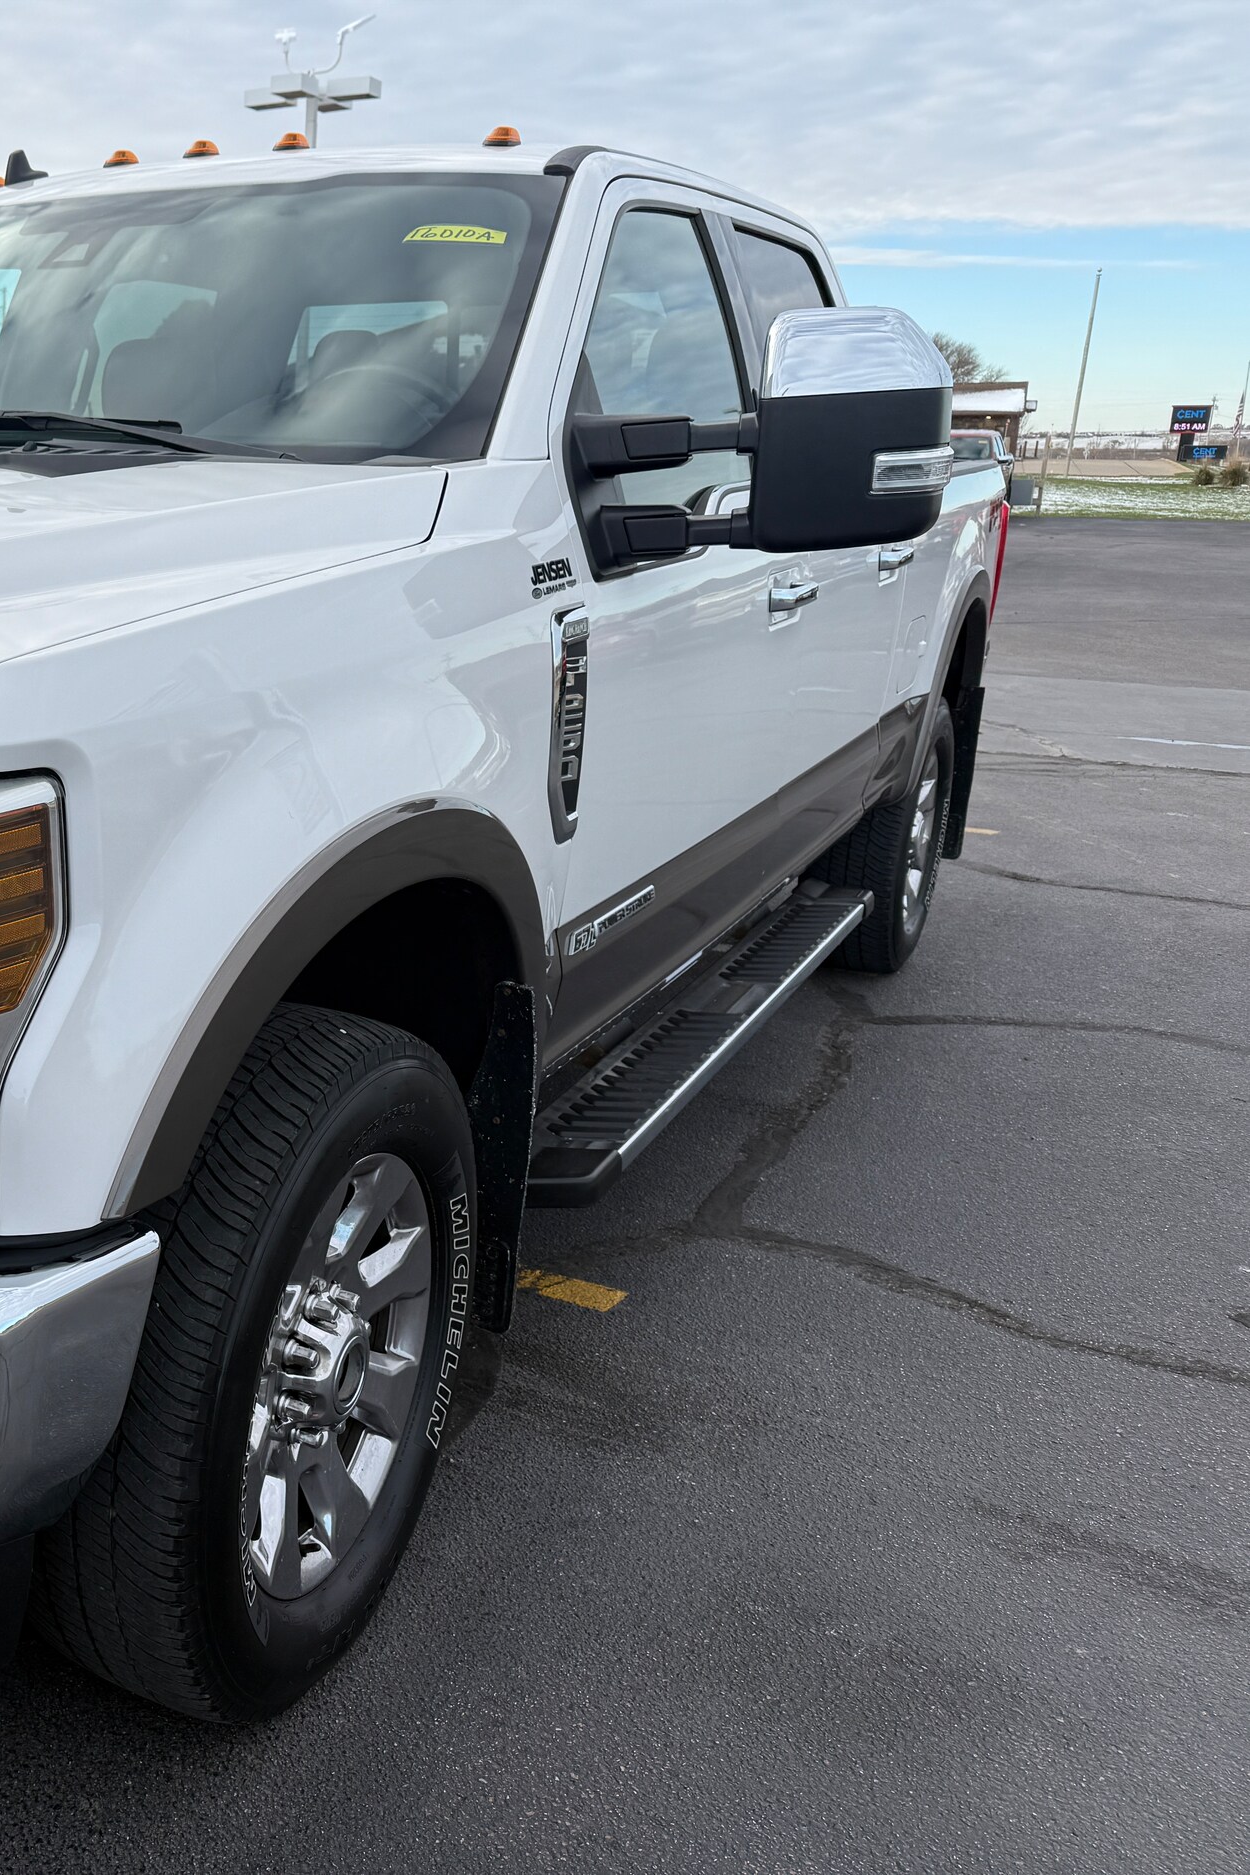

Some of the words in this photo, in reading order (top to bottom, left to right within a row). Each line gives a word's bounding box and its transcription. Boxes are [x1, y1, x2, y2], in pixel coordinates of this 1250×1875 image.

[1174, 423, 1191, 431] 8:51
[1192, 423, 1206, 431] AM
[530, 557, 572, 586] JENSEN
[426, 1192, 470, 1449] MICHELIN
